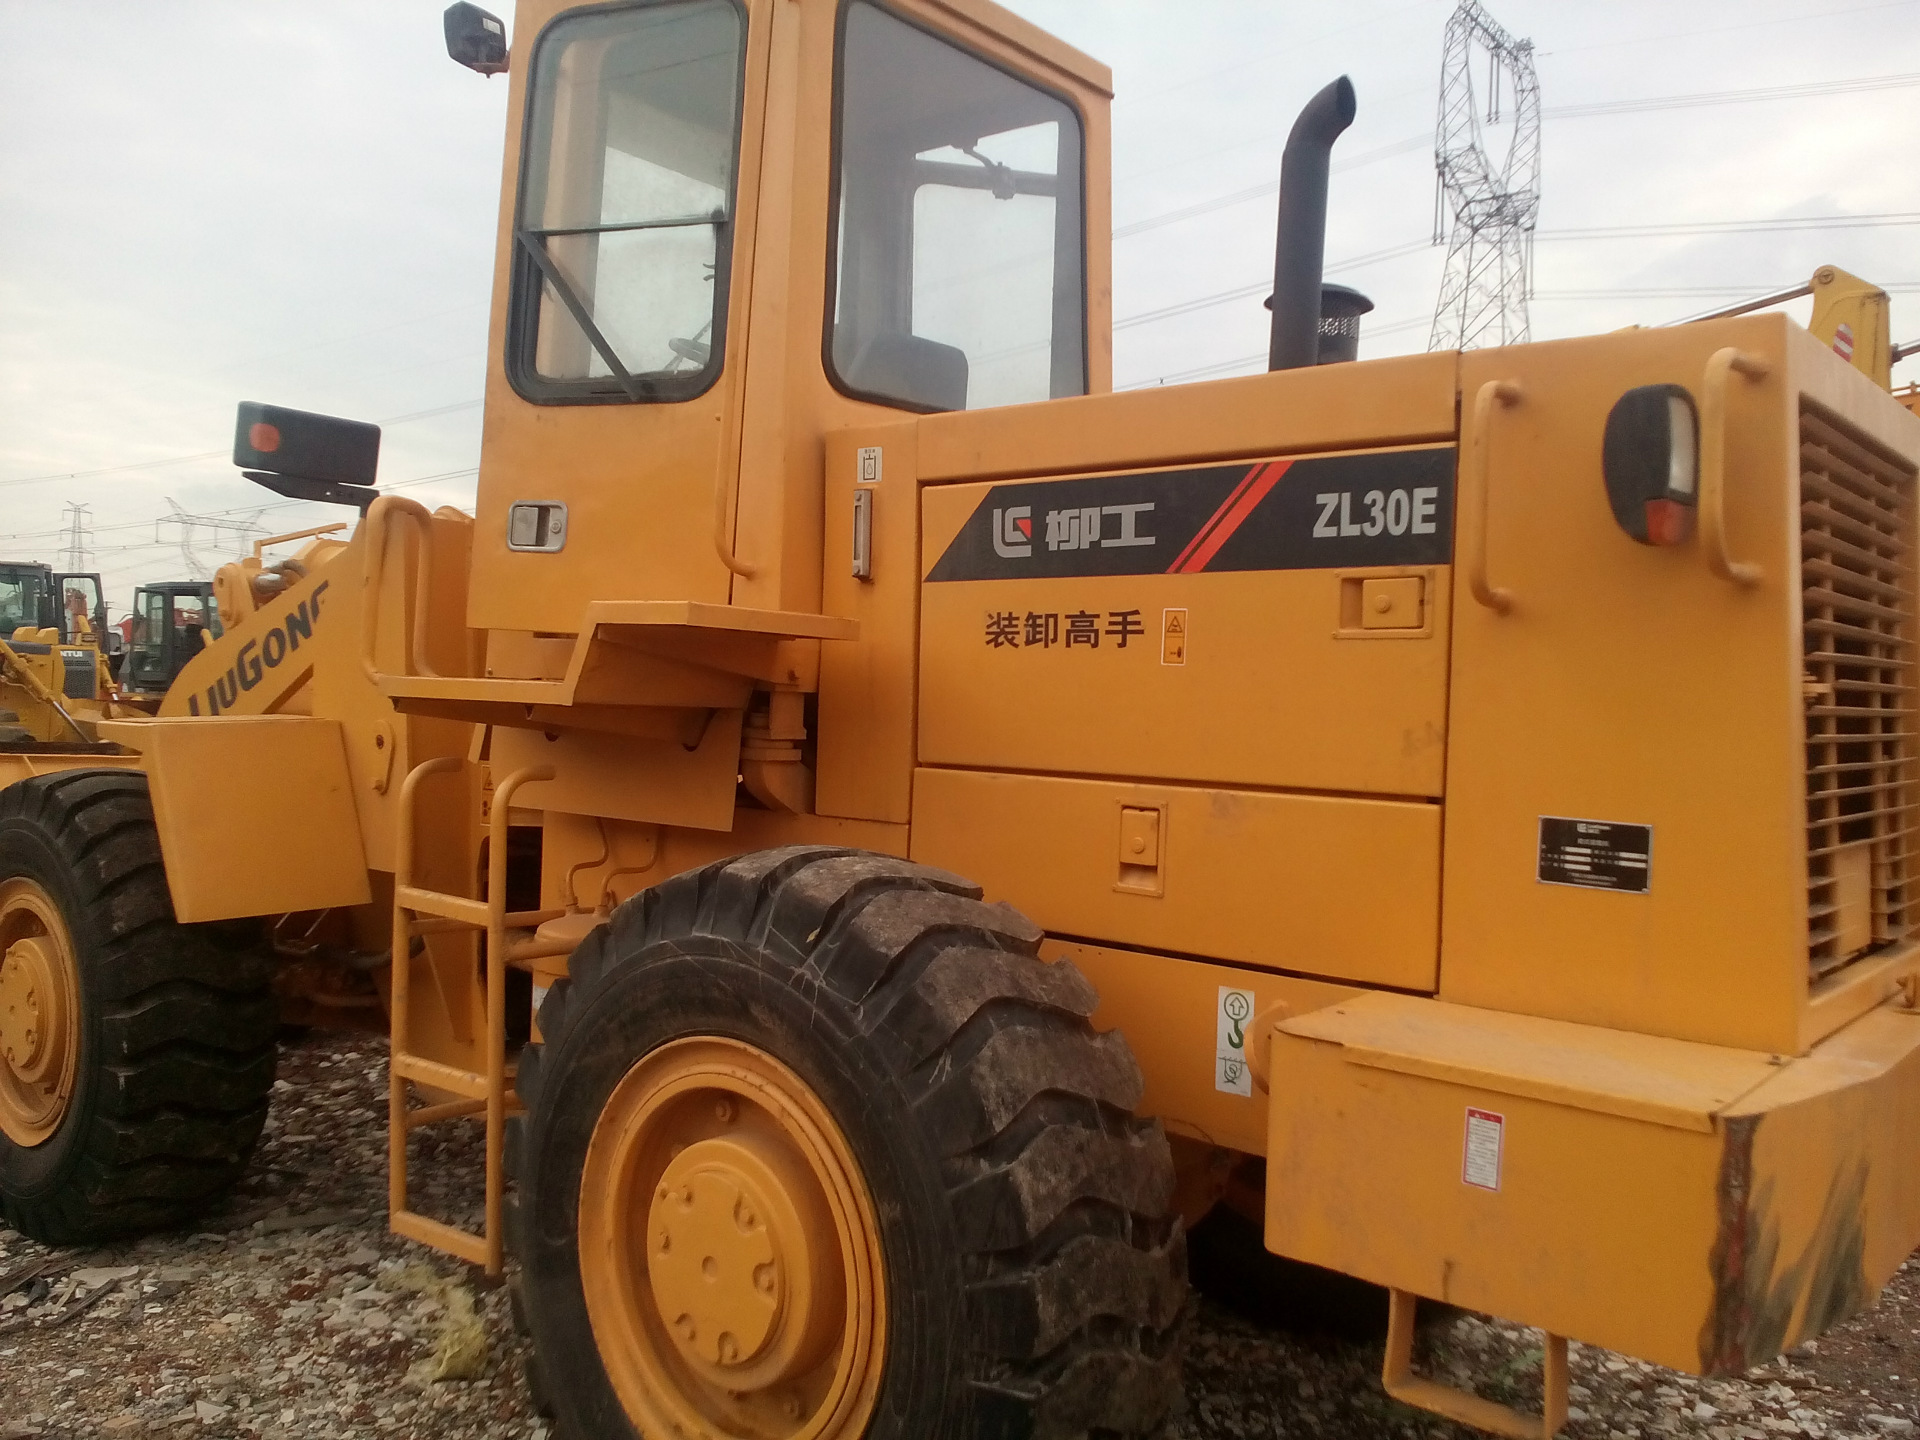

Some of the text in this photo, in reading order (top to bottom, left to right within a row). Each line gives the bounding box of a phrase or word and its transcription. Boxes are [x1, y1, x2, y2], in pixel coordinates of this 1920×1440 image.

[1045, 502, 1156, 551] 柳工
[1312, 487, 1439, 538] ZL30E
[985, 609, 1145, 649] 装卸高手
